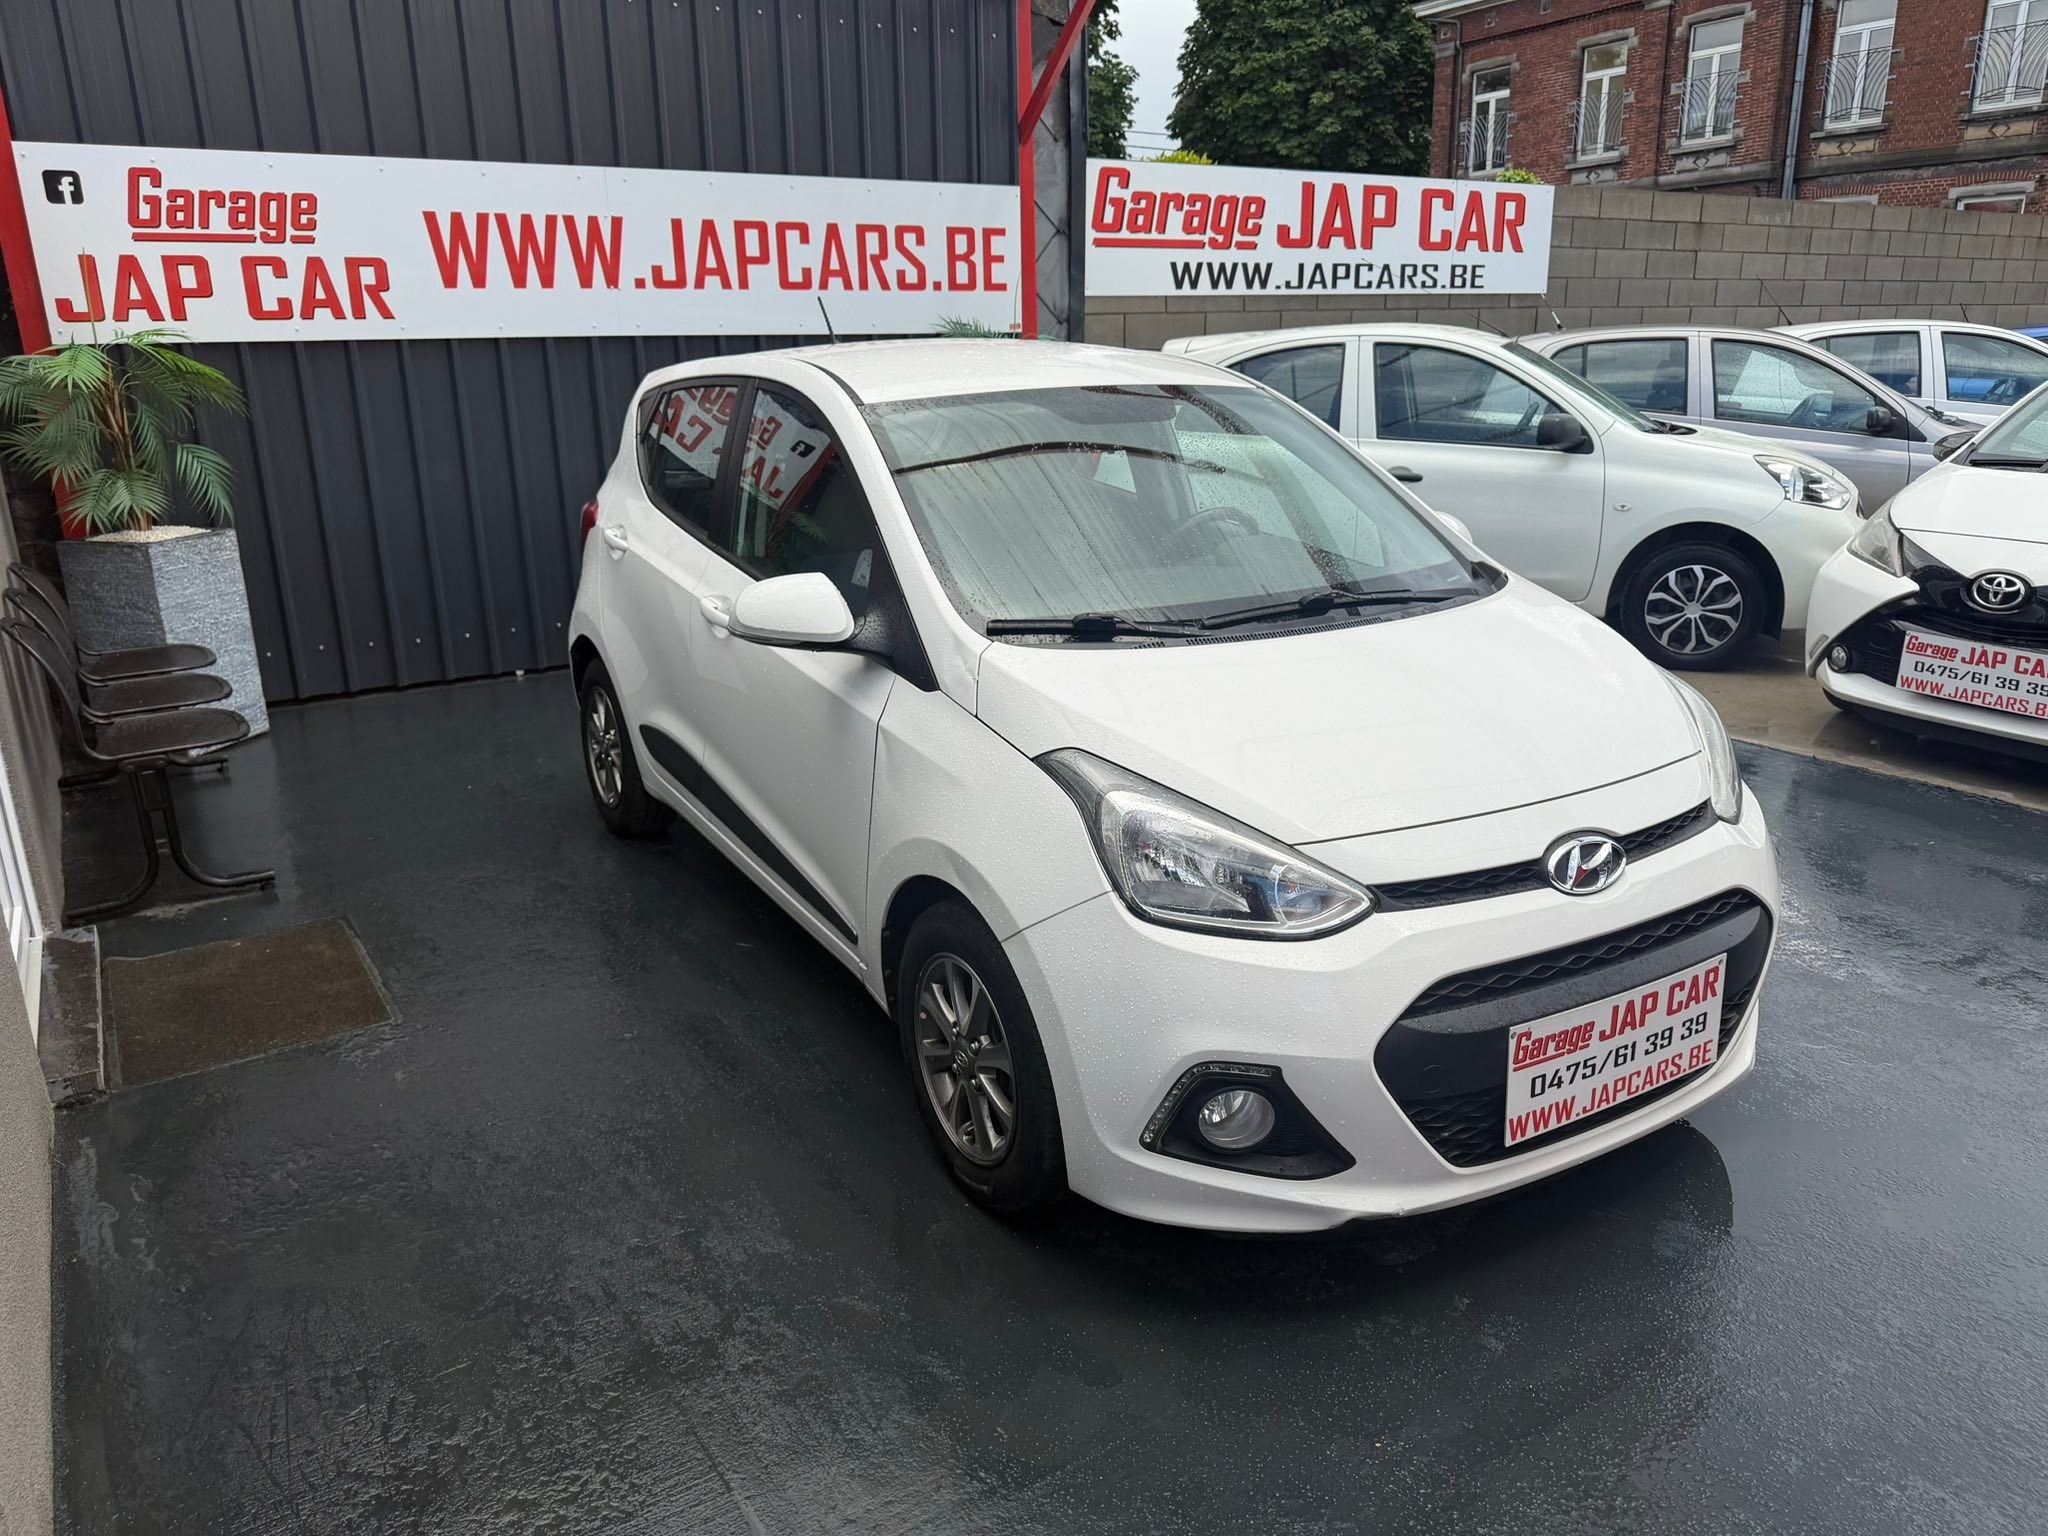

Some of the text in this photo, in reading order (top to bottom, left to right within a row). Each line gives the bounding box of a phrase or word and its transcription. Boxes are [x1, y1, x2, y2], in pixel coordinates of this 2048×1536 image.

[127, 166, 317, 244] Garage
[1091, 167, 1526, 253] Garage JAP CAR
[55, 254, 397, 323] JAP CAR
[422, 210, 1008, 292] WWW.JAPCARS.BE
[1169, 261, 1486, 291] WWW.JAPCARS.BE
[1906, 635, 2048, 679] Garage JAP CA
[1914, 661, 1989, 686] 0475/61
[1995, 676, 2020, 691] 39
[1900, 675, 2048, 718] WWW.JAPCARS.B
[1512, 966, 1720, 1066] Garage JAP CAR
[1530, 1011, 1708, 1098] 0475/61 39 39
[1509, 1039, 1713, 1142] WWW.JAPCARS.BE
